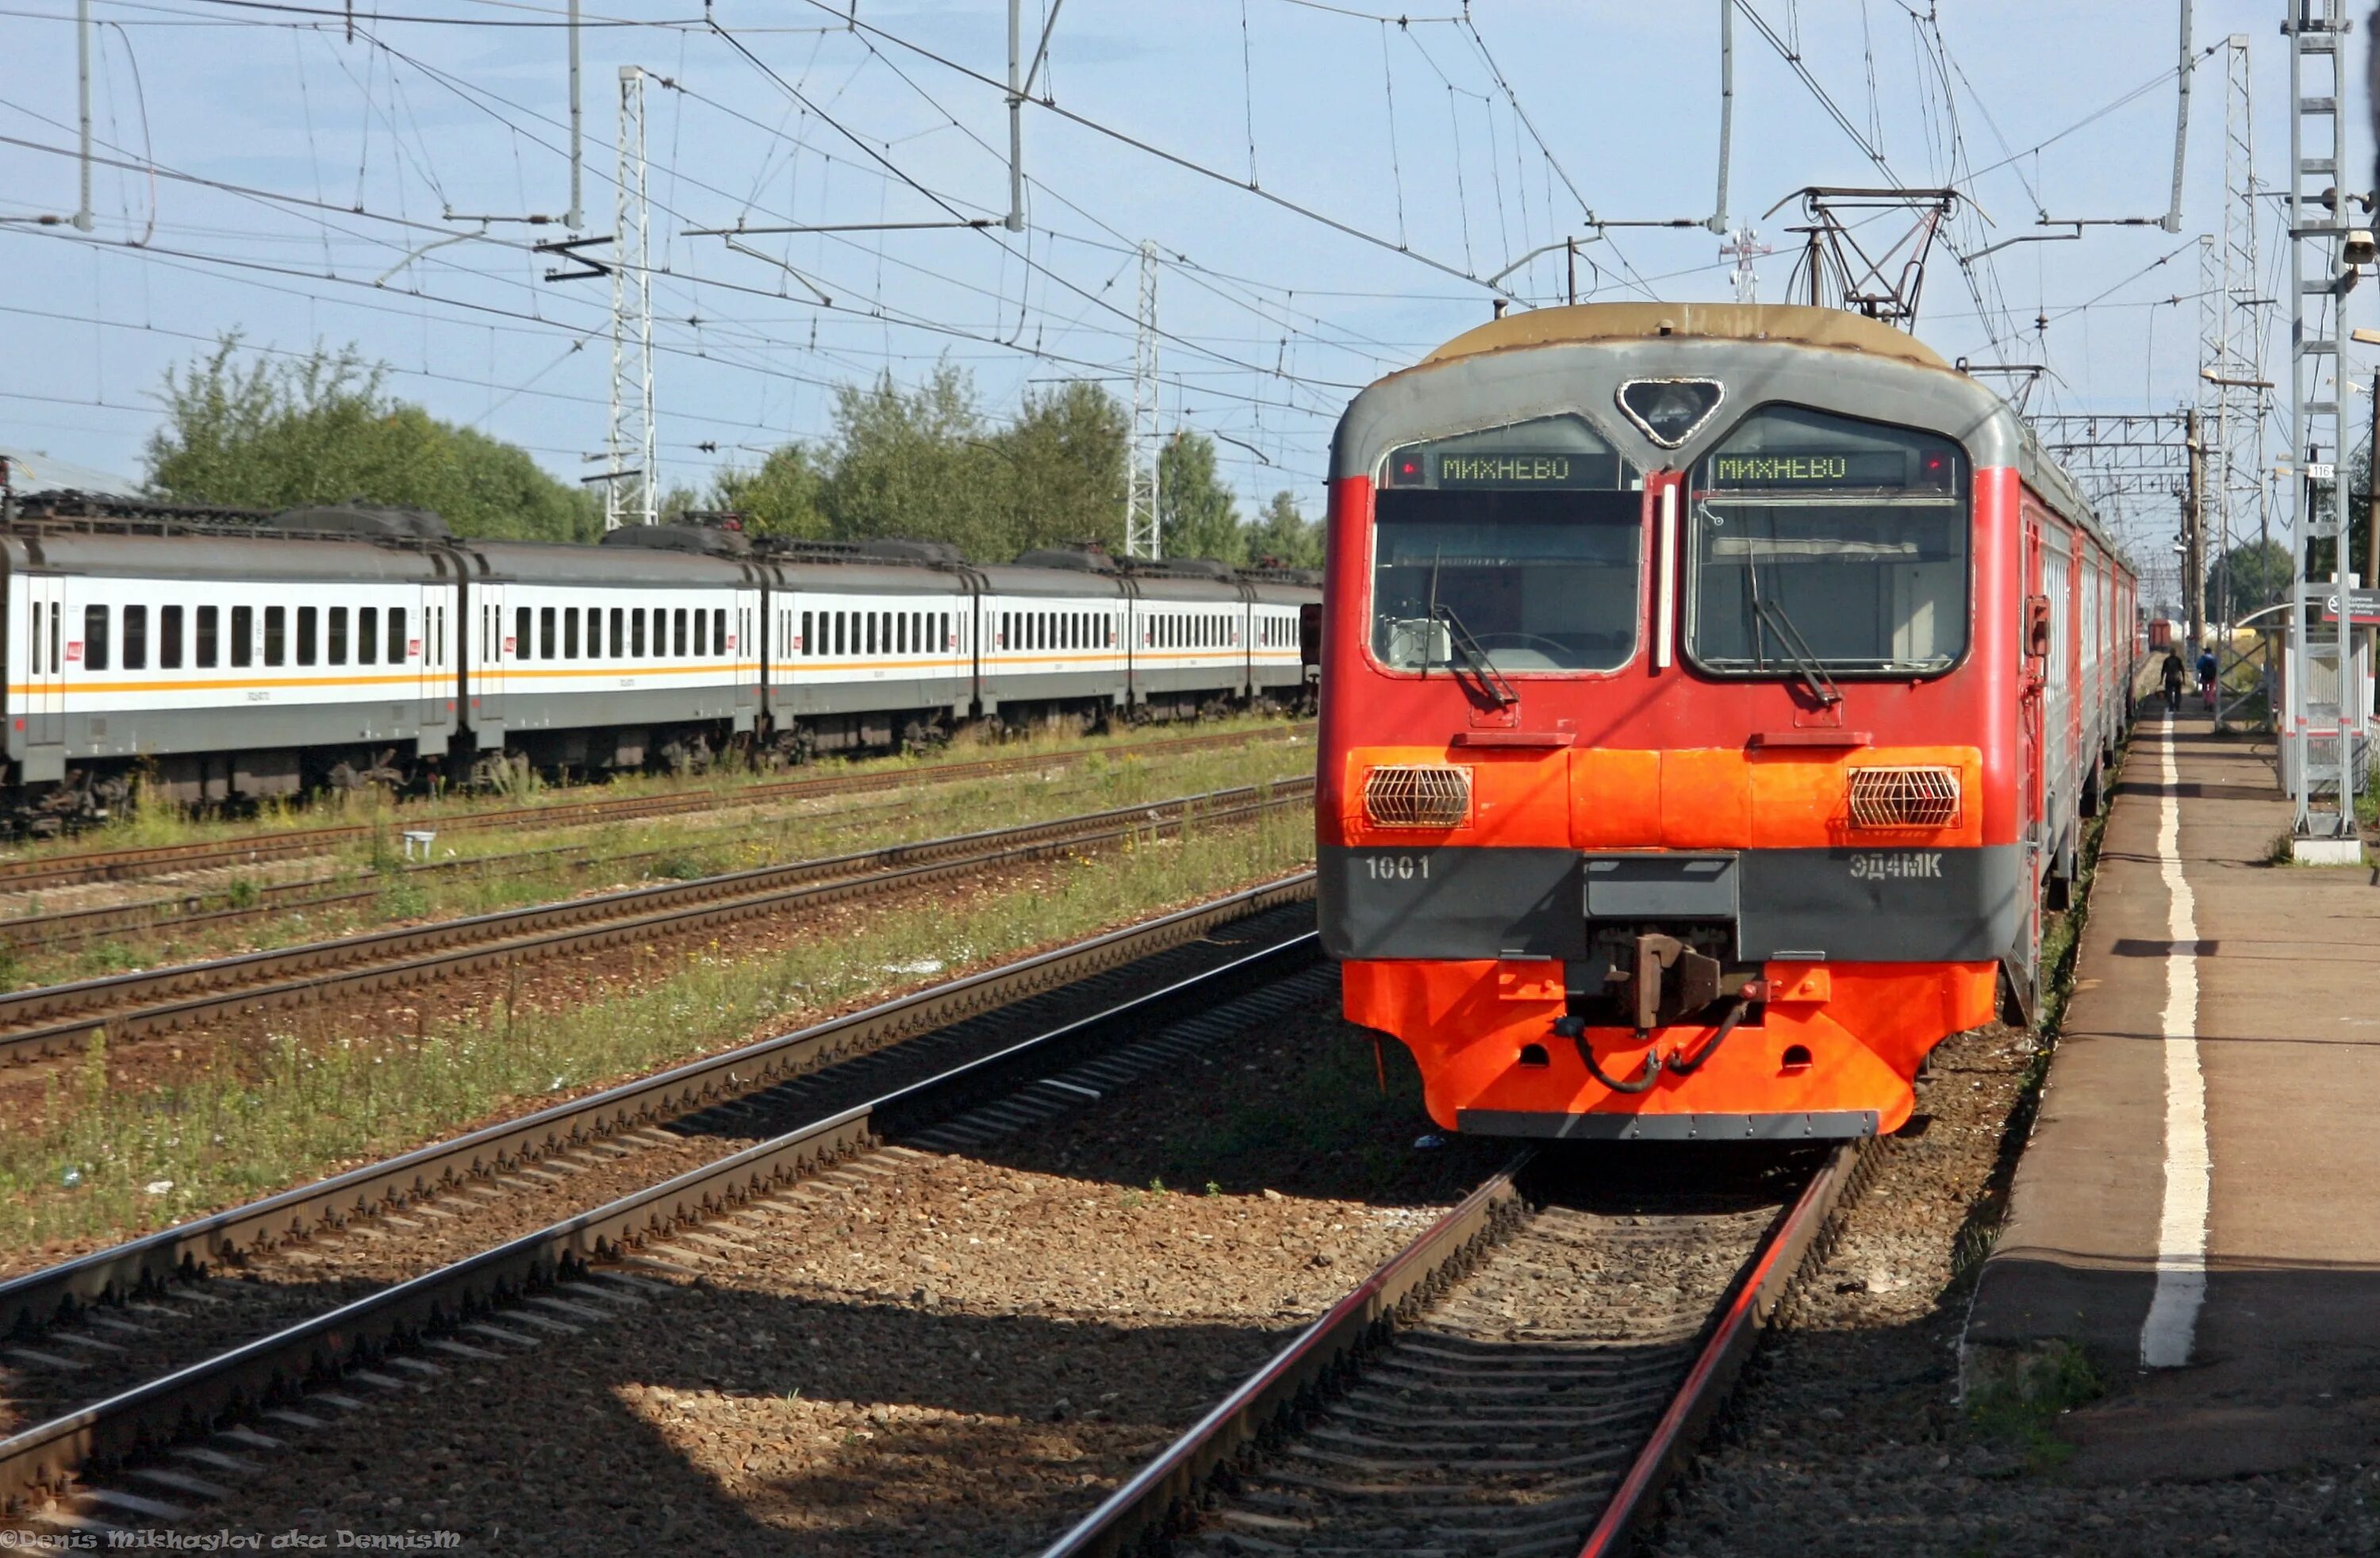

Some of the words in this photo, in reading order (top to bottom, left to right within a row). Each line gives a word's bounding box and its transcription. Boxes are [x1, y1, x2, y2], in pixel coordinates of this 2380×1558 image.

[1443, 456, 1569, 480] МИХНЕВО
[1719, 456, 1846, 479] МИХНЕВО
[2314, 466, 2330, 477] 116
[1366, 855, 1429, 879] 1001
[1850, 853, 1943, 880] ЭД4МК
